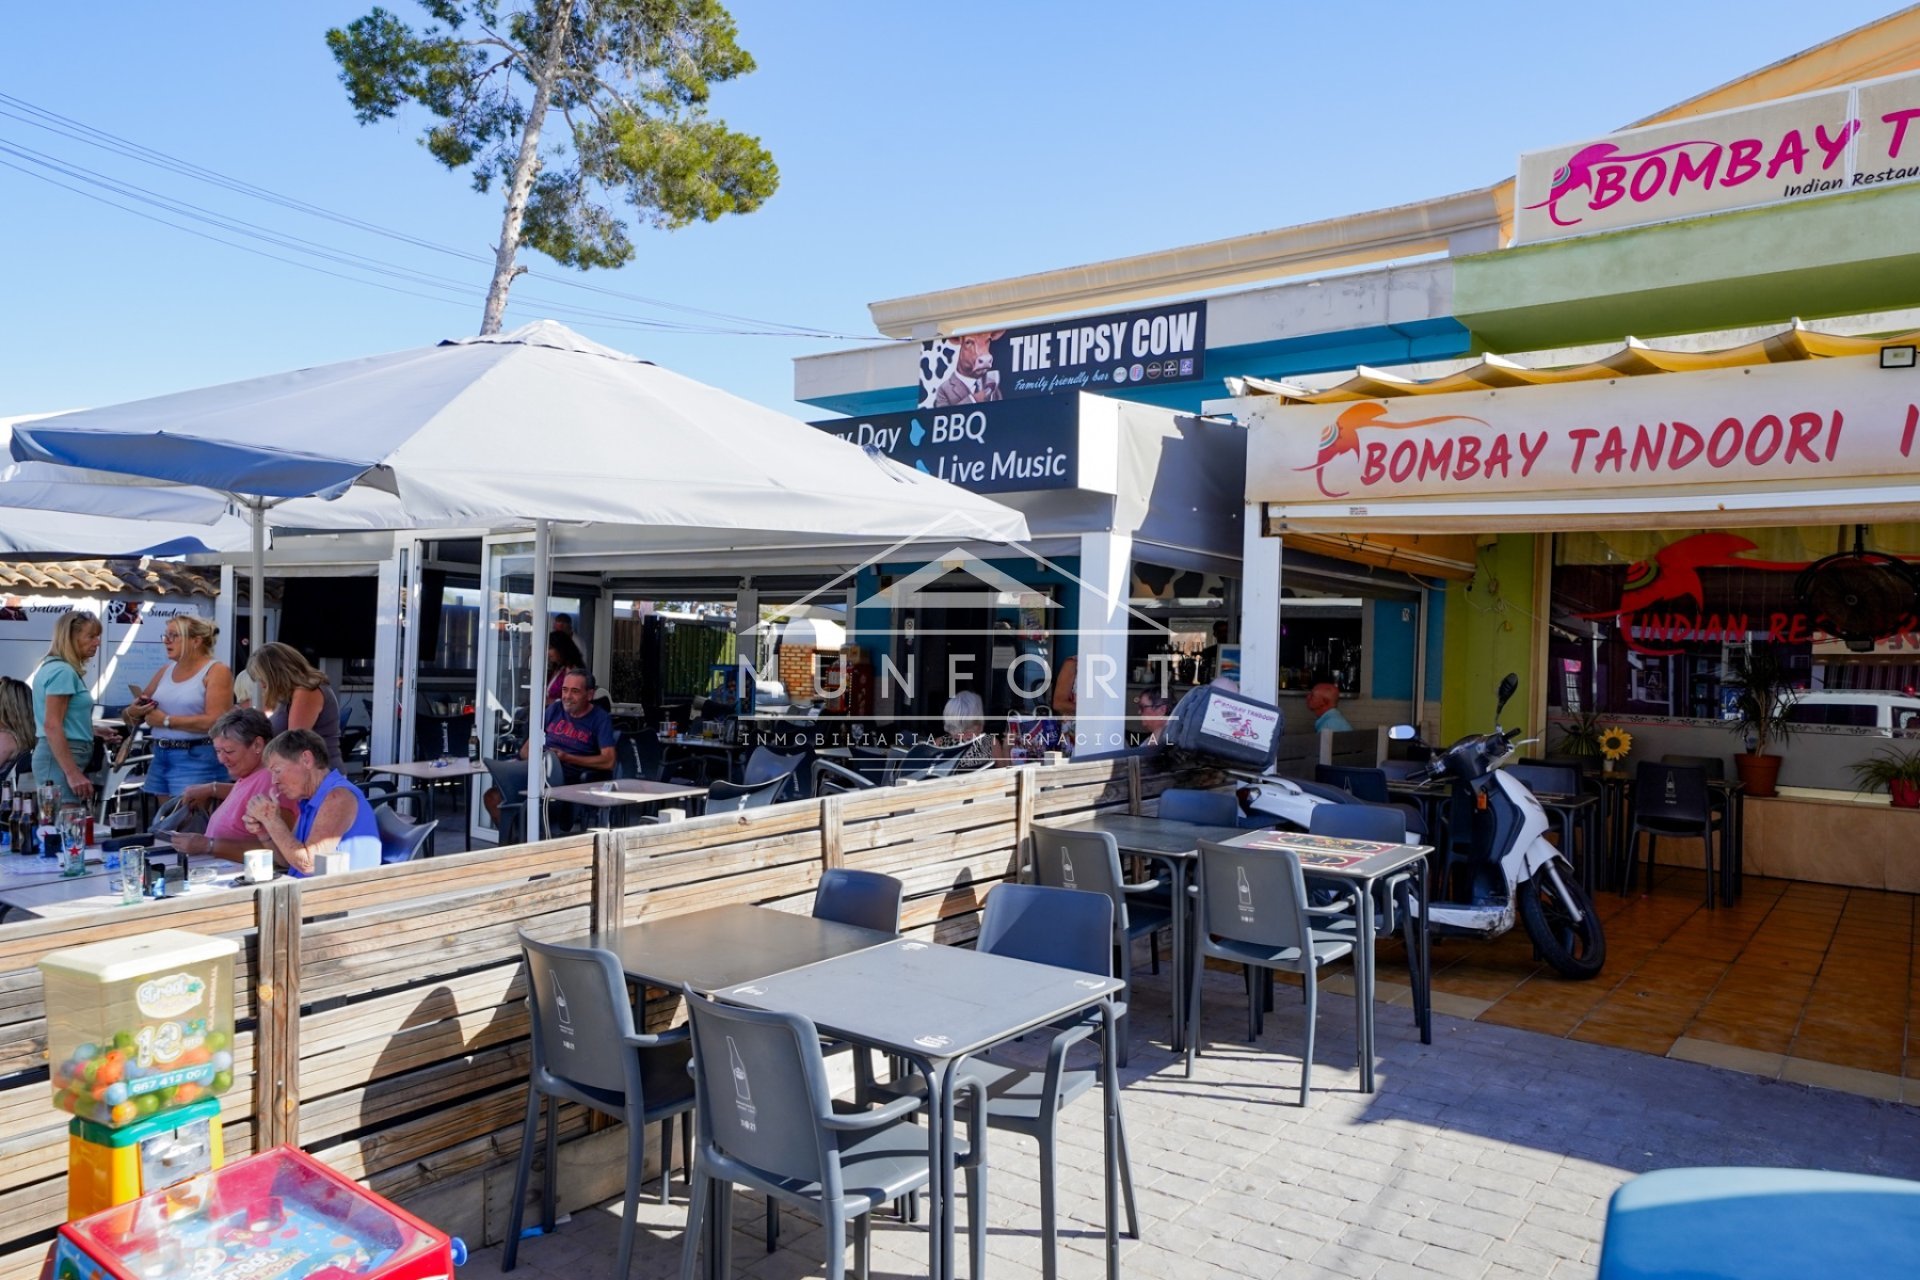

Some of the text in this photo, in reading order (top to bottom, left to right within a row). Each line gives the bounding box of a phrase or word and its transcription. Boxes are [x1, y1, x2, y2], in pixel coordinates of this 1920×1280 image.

[1588, 118, 1861, 211] BOMBAY
[1784, 179, 1844, 198] Indian
[1010, 311, 1198, 373] THE TIPSY COW
[1014, 376, 1050, 393] Family
[1049, 370, 1090, 391] friendly
[1092, 369, 1110, 382] bar
[858, 410, 987, 453] Day BBQ
[1360, 430, 1549, 486] BOMBAY
[1568, 409, 1844, 474] TANDOORI
[937, 446, 1067, 483] Live Music
[1639, 612, 1749, 644] INDIAN
